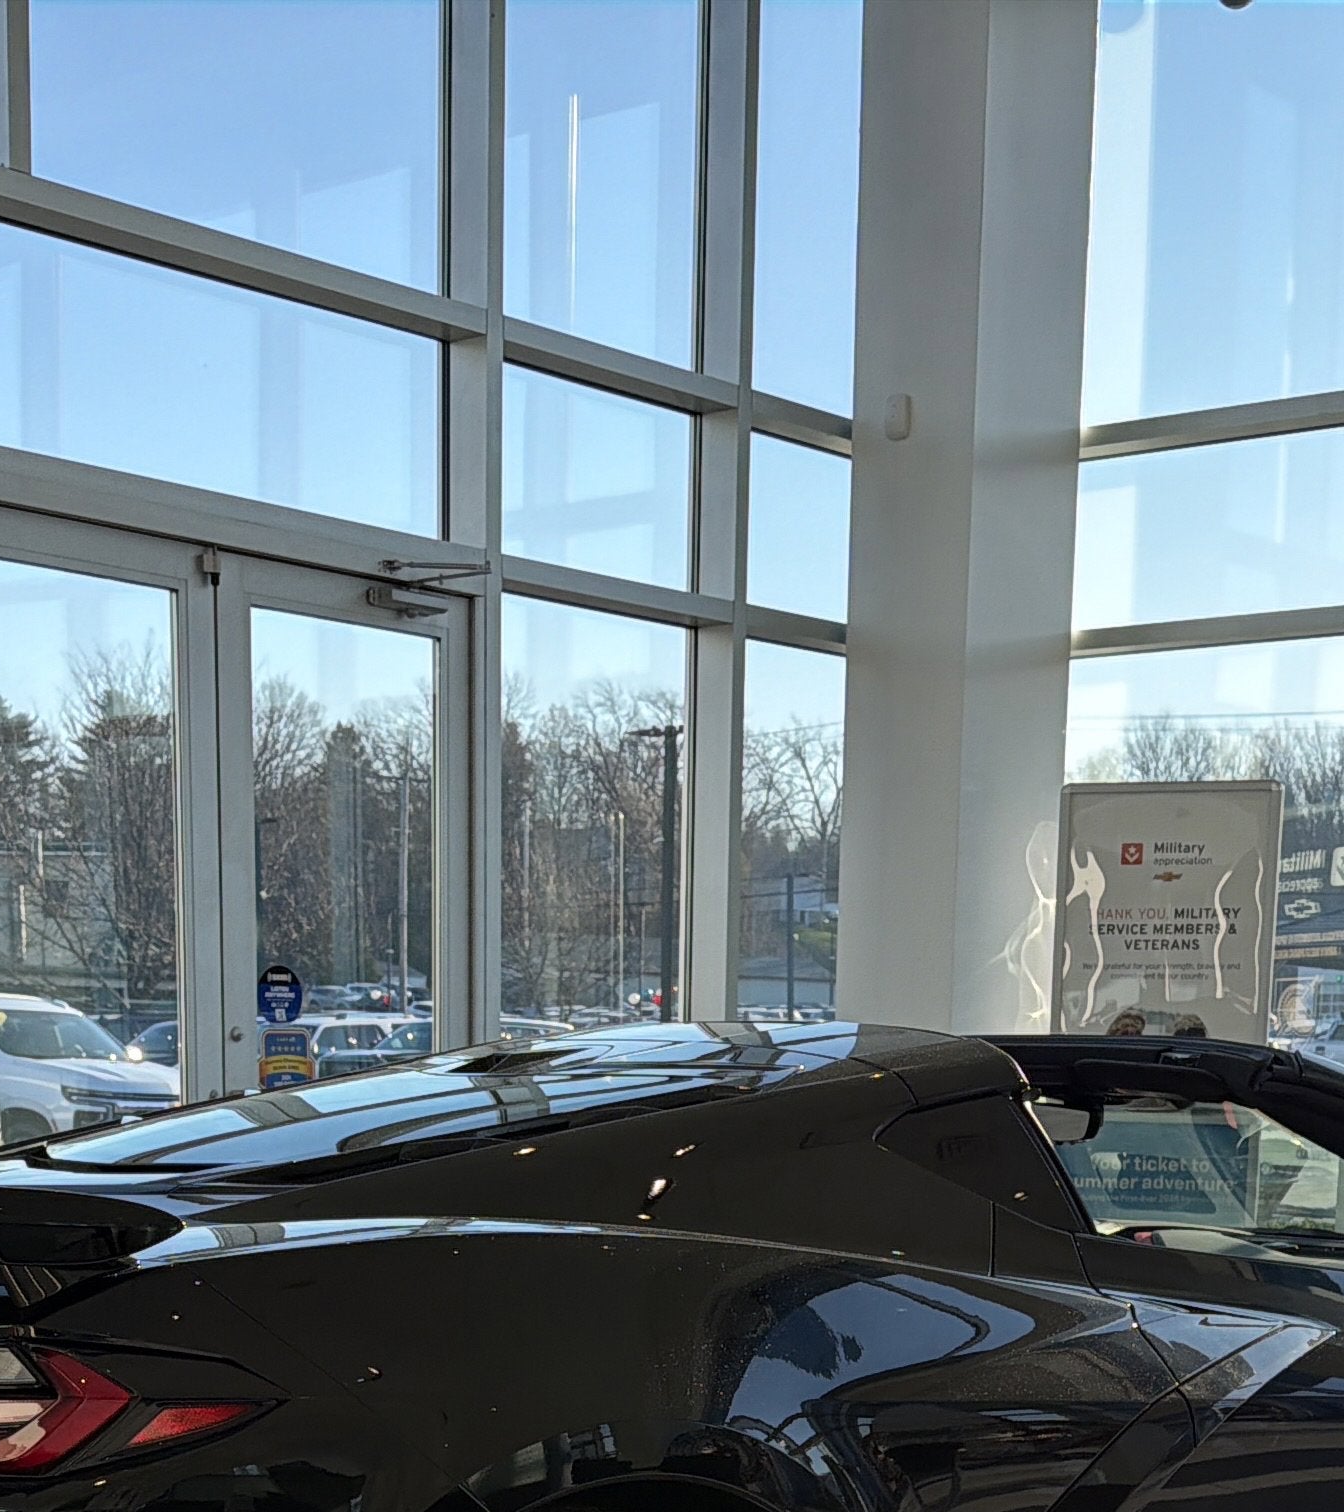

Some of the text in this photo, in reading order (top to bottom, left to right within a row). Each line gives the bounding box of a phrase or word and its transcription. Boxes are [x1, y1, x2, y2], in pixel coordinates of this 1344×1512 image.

[1153, 841, 1205, 856] Military
[1153, 856, 1213, 866] appreciation
[1089, 908, 1133, 920] HANK
[1138, 908, 1169, 921] YOU,
[1152, 924, 1222, 935] MEMBERS
[1228, 924, 1238, 935] &
[1123, 938, 1201, 951] VETERANS
[1092, 1154, 1211, 1173] Your ticket to
[1074, 1176, 1141, 1190] ummer
